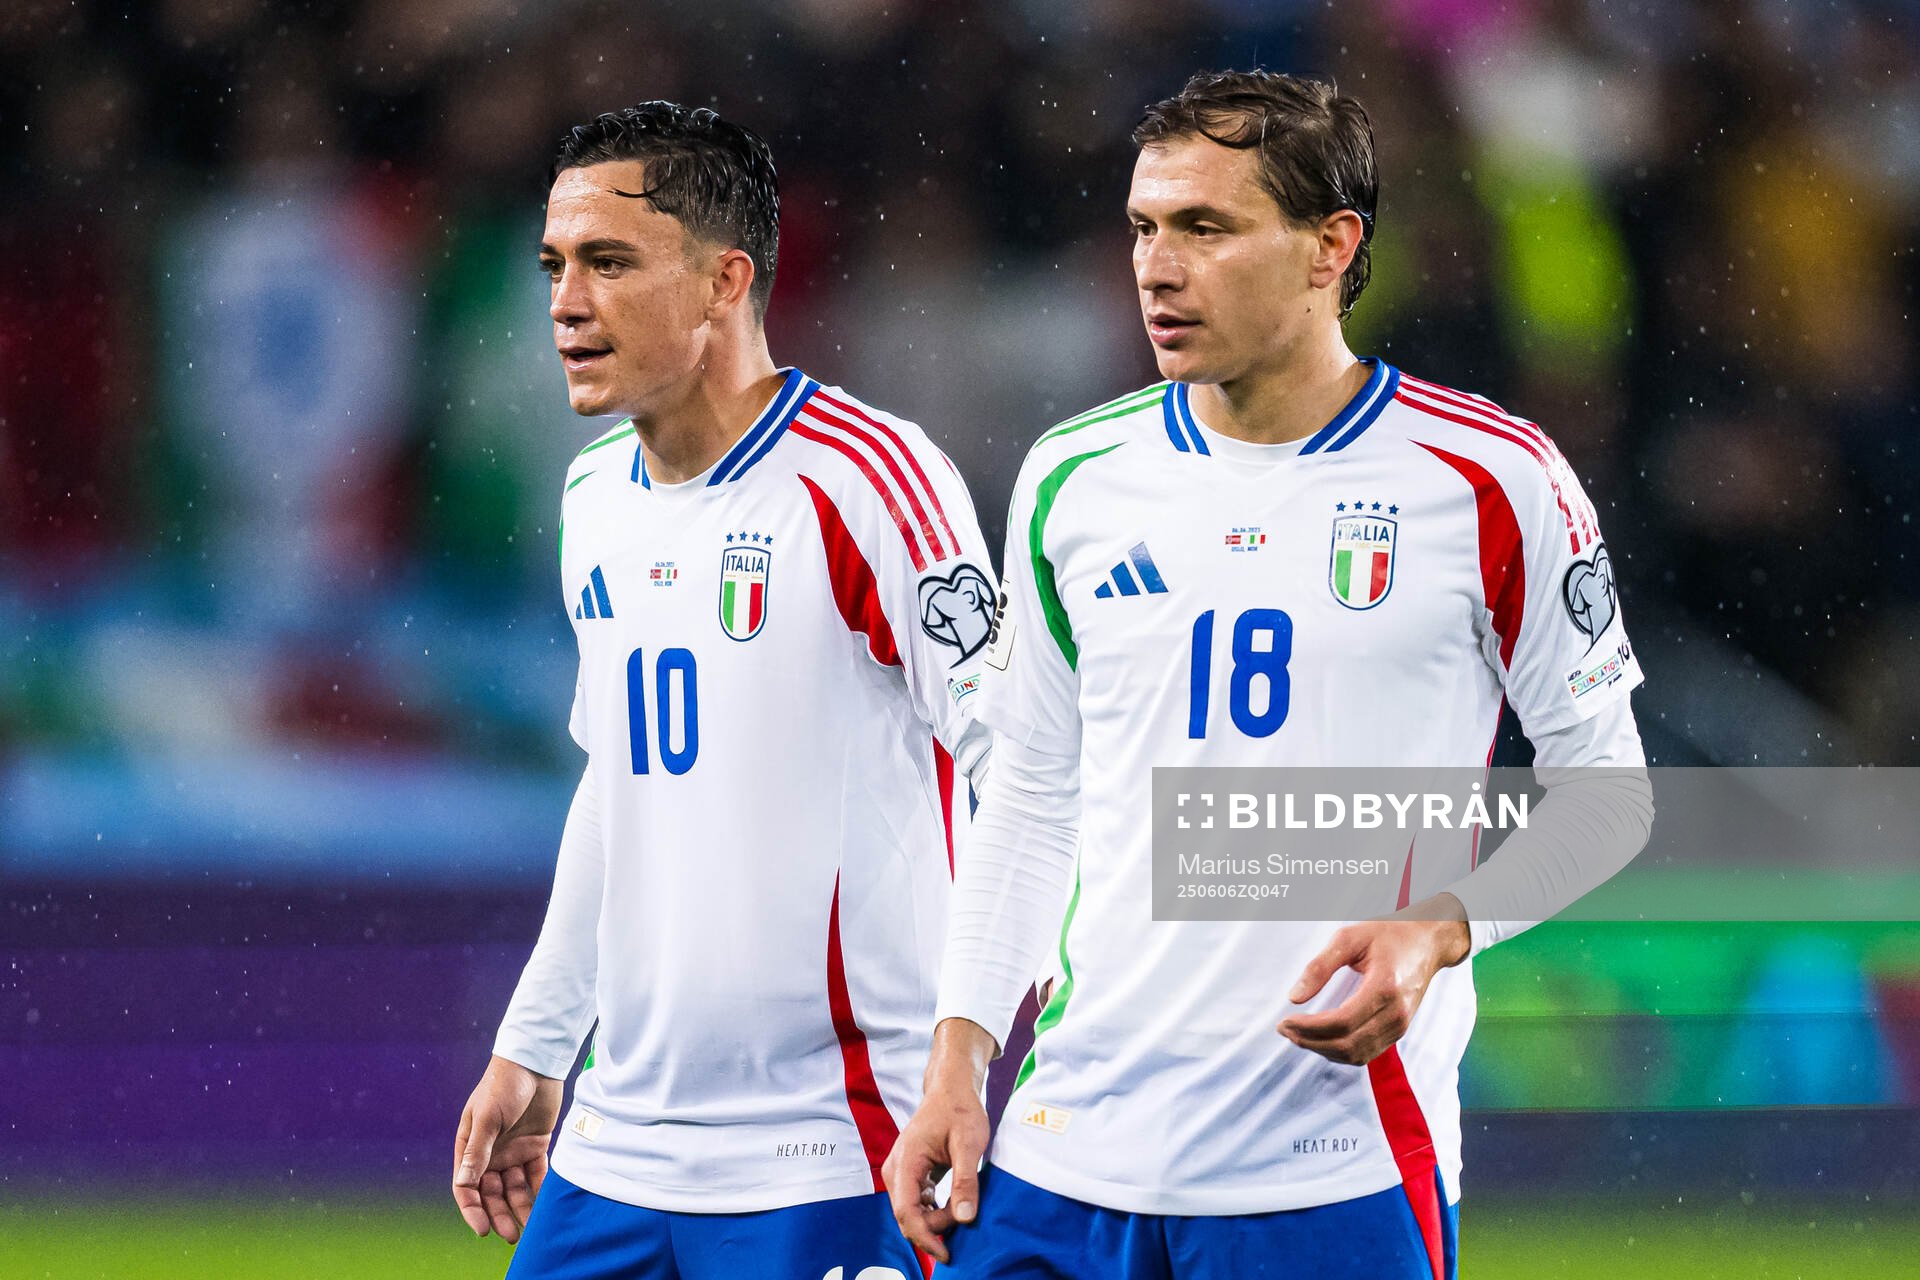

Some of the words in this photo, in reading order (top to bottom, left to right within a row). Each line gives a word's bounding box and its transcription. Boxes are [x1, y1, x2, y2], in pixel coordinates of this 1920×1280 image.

[1337, 523, 1390, 542] ITALIA
[725, 554, 765, 574] ITALIA
[1188, 608, 1293, 739] 18
[1571, 657, 1619, 695] FOUNDATION
[627, 648, 698, 775] 10
[776, 1143, 837, 1157] HEAT.RDY
